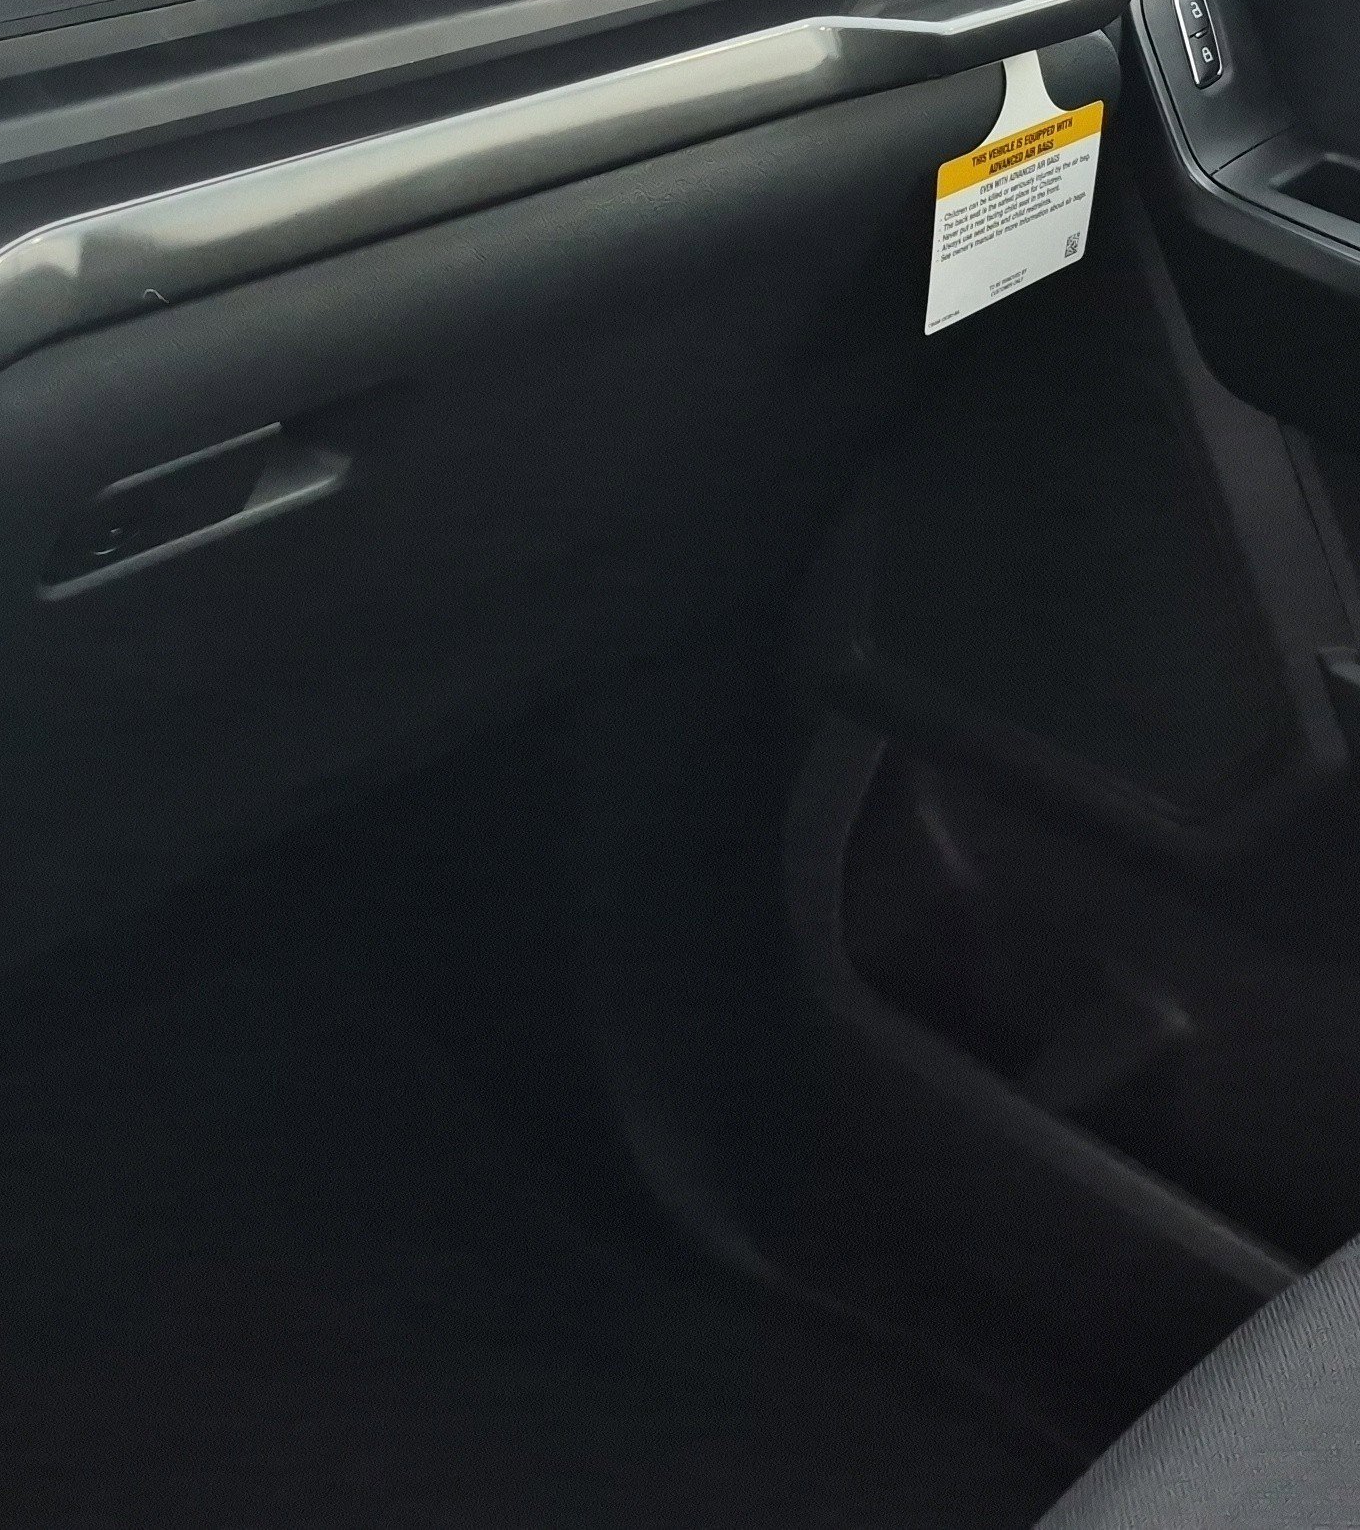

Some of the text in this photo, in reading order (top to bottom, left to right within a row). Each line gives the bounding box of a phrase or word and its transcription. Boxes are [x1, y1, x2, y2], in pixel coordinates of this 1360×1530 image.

[972, 117, 1073, 167] THIS VEHICLE IS EQUIPPED WITH
[989, 138, 1054, 175] ADVANCED AIR BAGS
